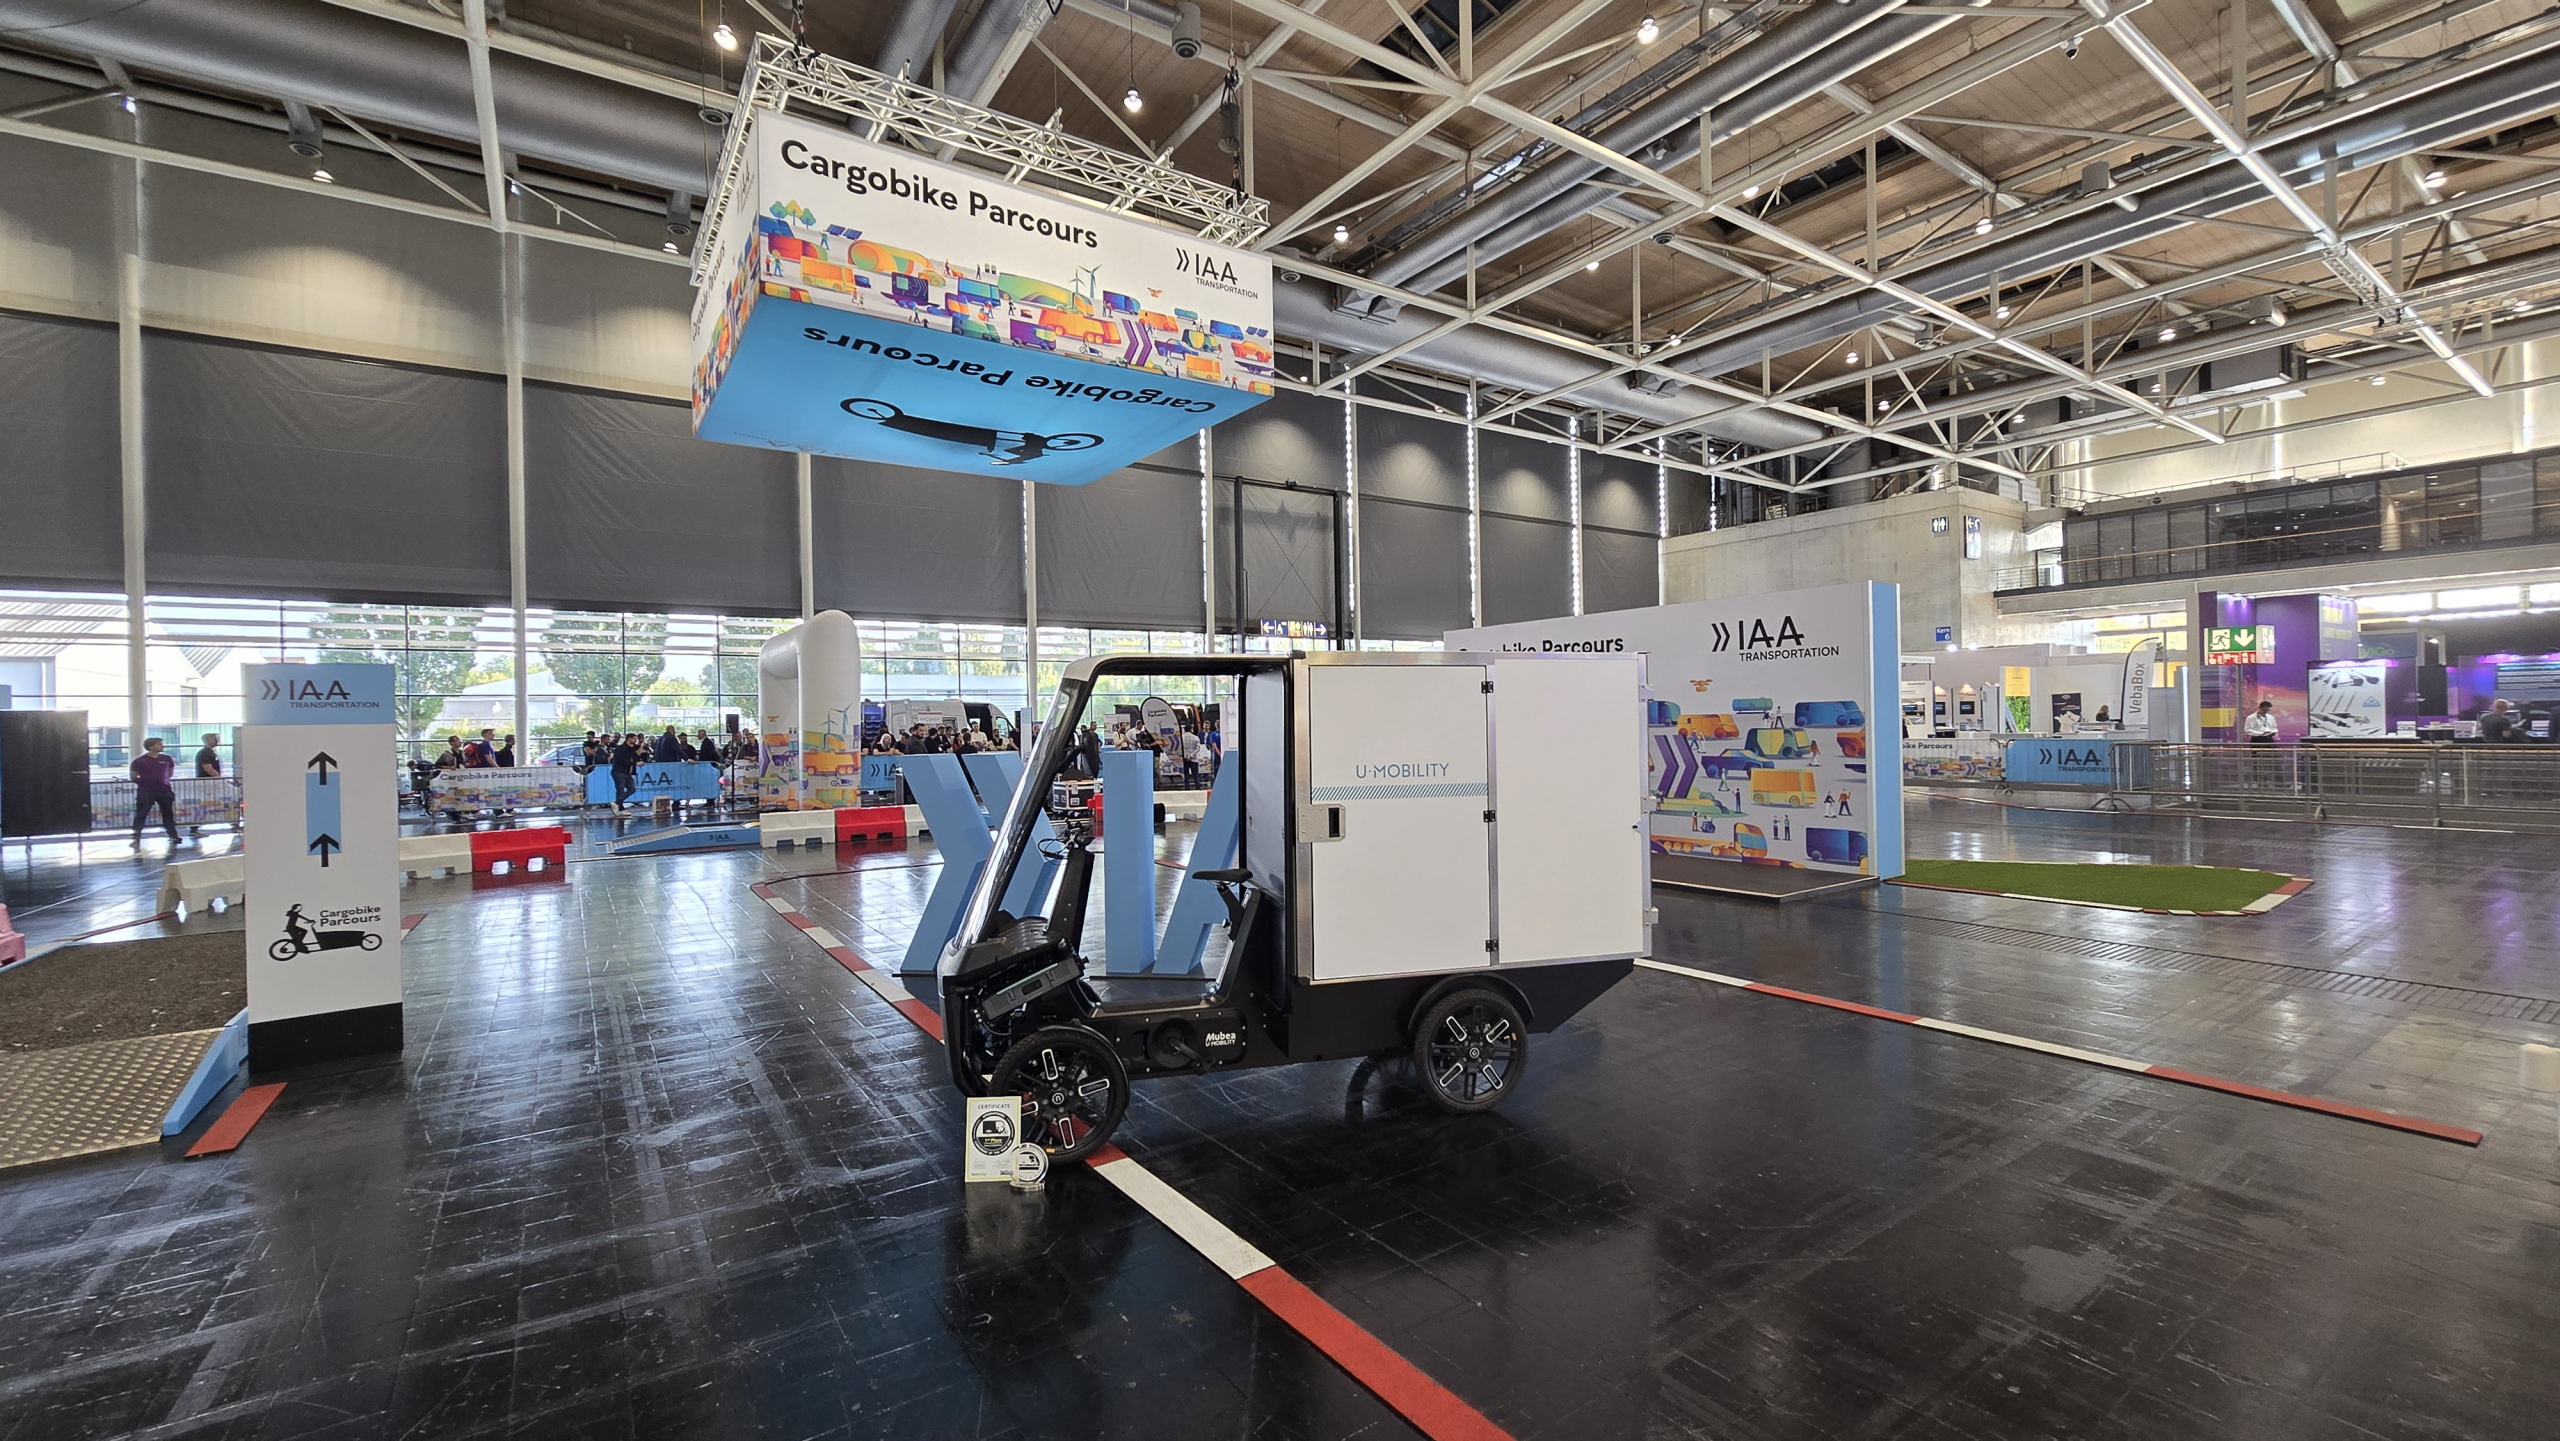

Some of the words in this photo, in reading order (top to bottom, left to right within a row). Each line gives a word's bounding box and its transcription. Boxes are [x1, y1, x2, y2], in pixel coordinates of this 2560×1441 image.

[781, 139, 958, 211] Cargobike
[969, 190, 1098, 249] Parcours
[1195, 253, 1238, 286] IAA
[1195, 276, 1258, 300] TRANSPORTATION
[802, 326, 1015, 386] Parcours
[1026, 373, 1217, 414] Cargobike
[1738, 615, 1805, 651] IAA
[1738, 645, 1840, 662] TRANSPORTATION
[289, 679, 351, 700] IAA
[2128, 662, 2146, 714] VebaBox
[289, 701, 380, 709] TRANSPORTATION
[2057, 748, 2102, 766] IAA
[440, 773, 489, 782] Cargobike
[491, 771, 532, 779] Parcours
[320, 905, 381, 919] Cargobike
[320, 914, 381, 927] Parcours
[1205, 1031, 1237, 1042] Mubea
